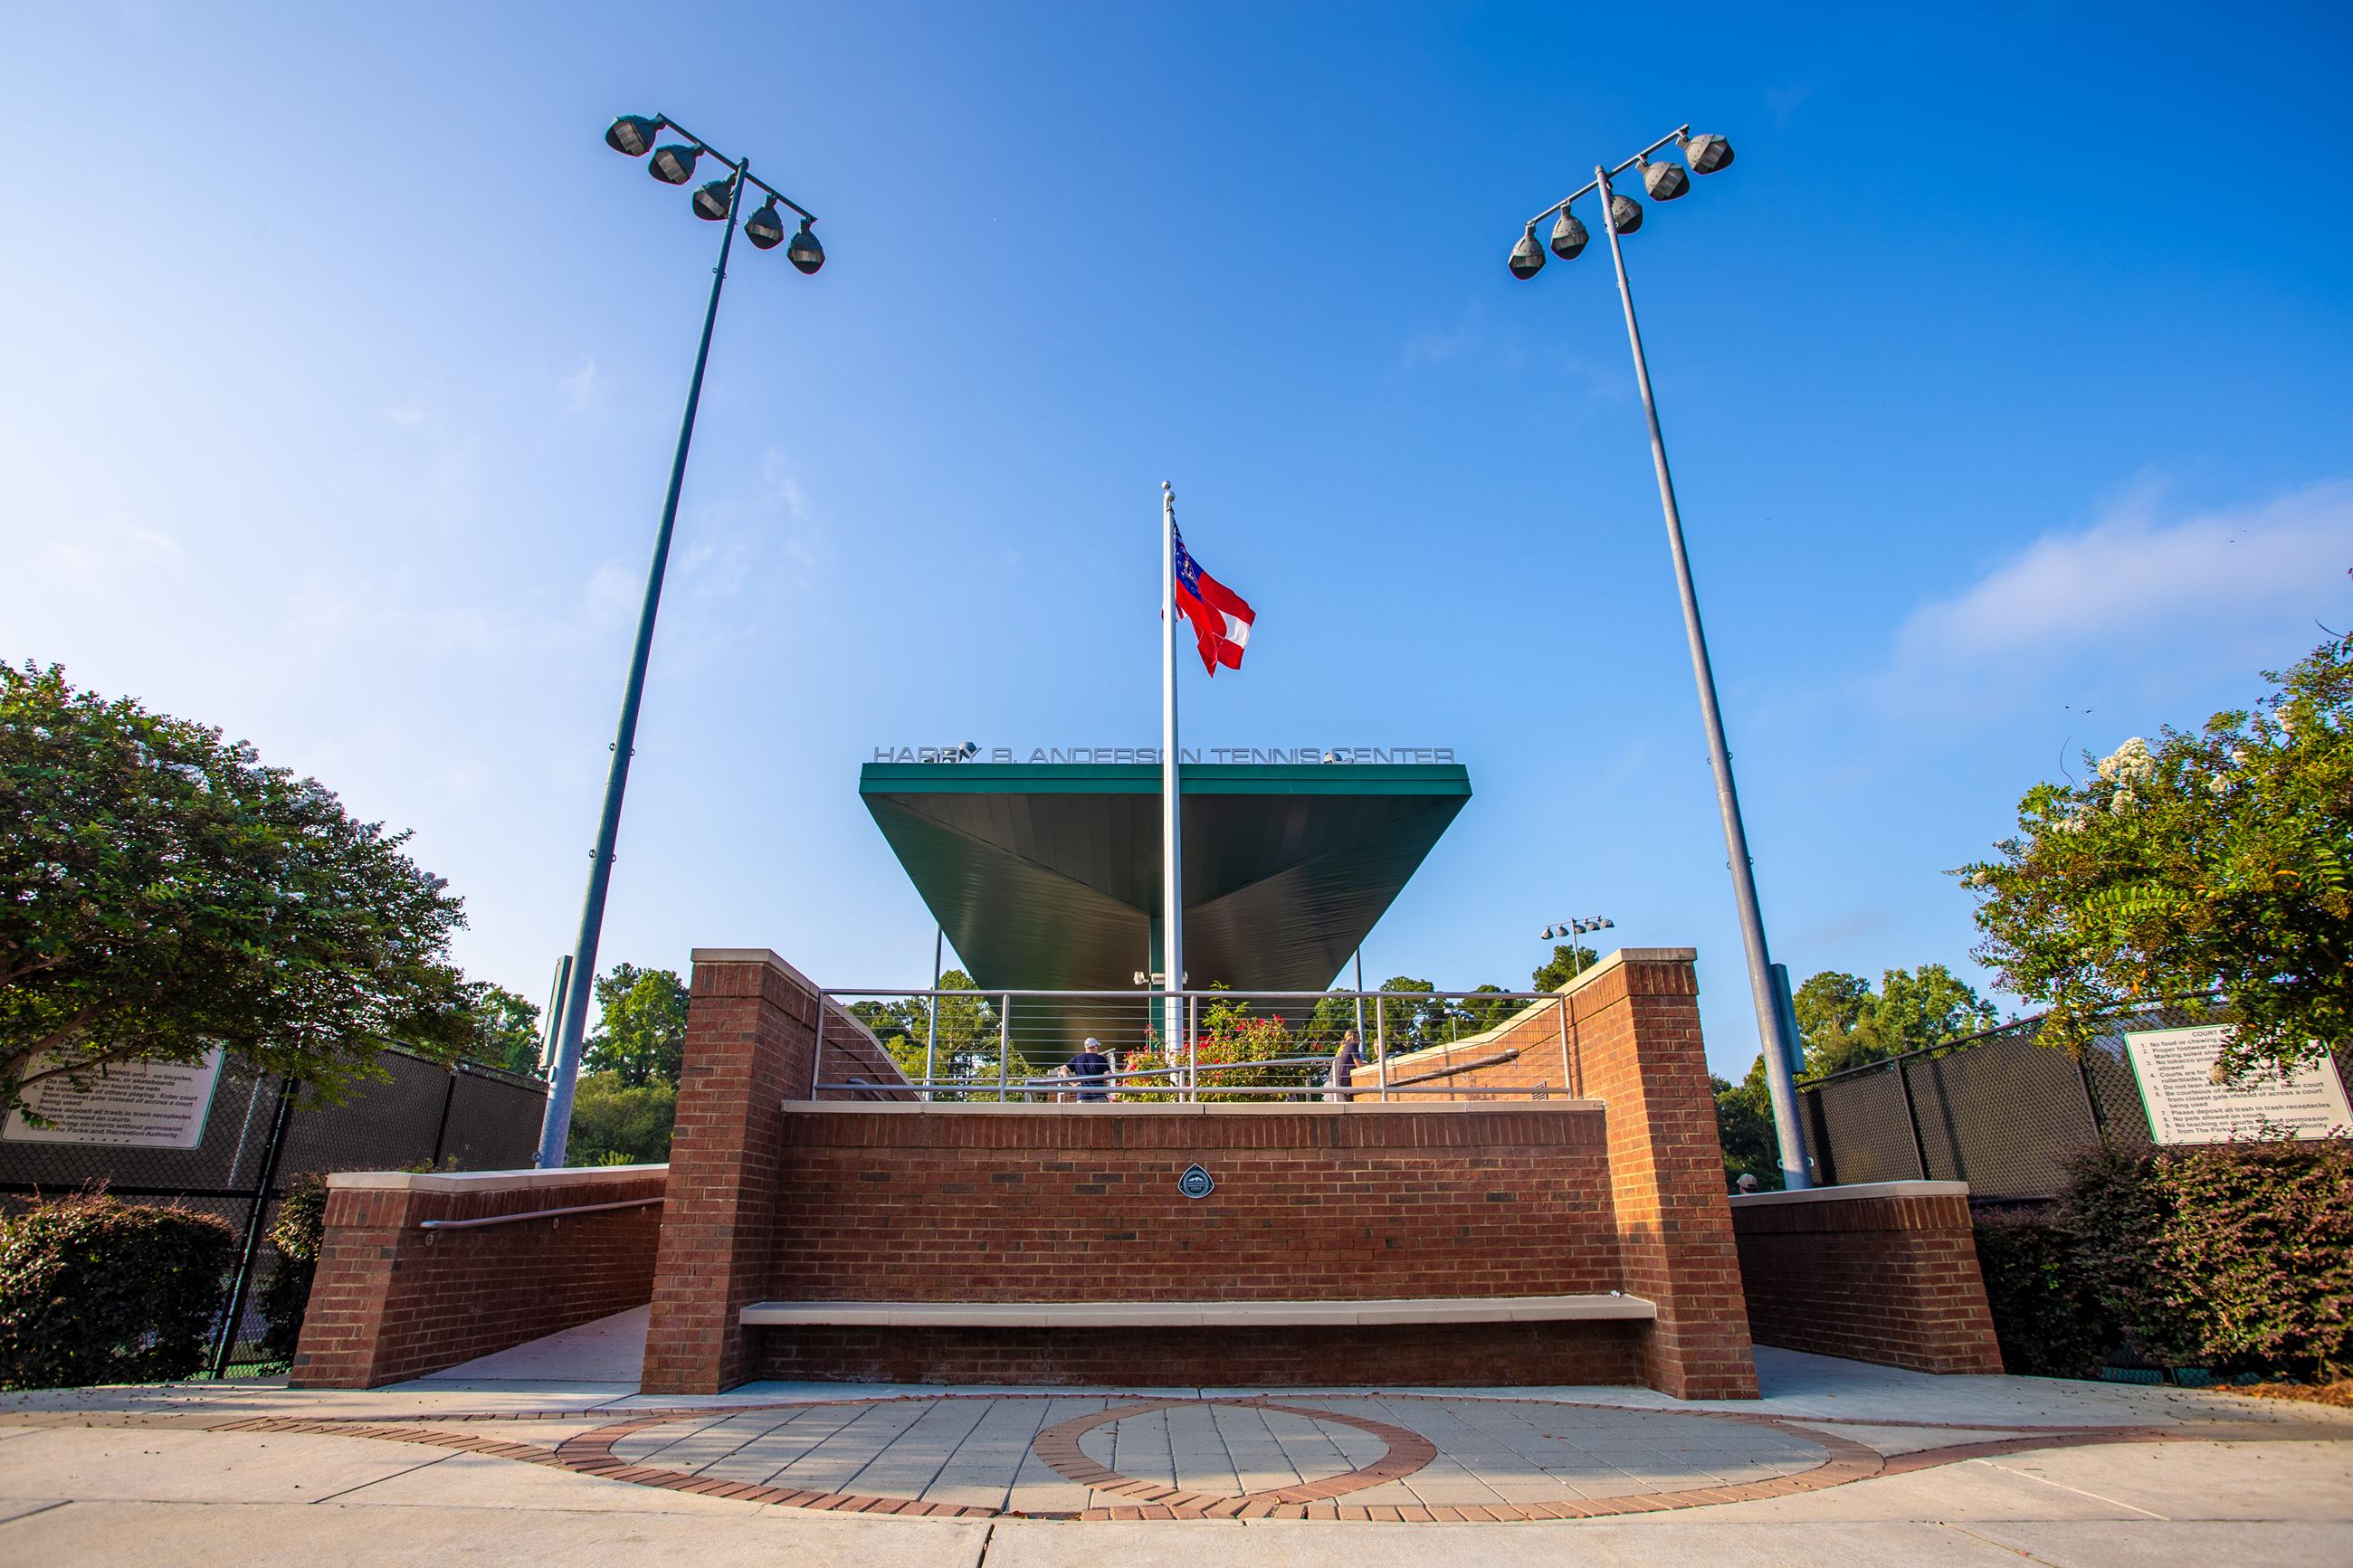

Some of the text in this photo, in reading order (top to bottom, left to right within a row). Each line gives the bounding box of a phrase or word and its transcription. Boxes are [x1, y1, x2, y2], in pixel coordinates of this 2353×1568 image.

[874, 746, 1454, 765] HARRY B. ANDERSN TENNIS CENTER
[164, 1073, 194, 1082] bicycles,
